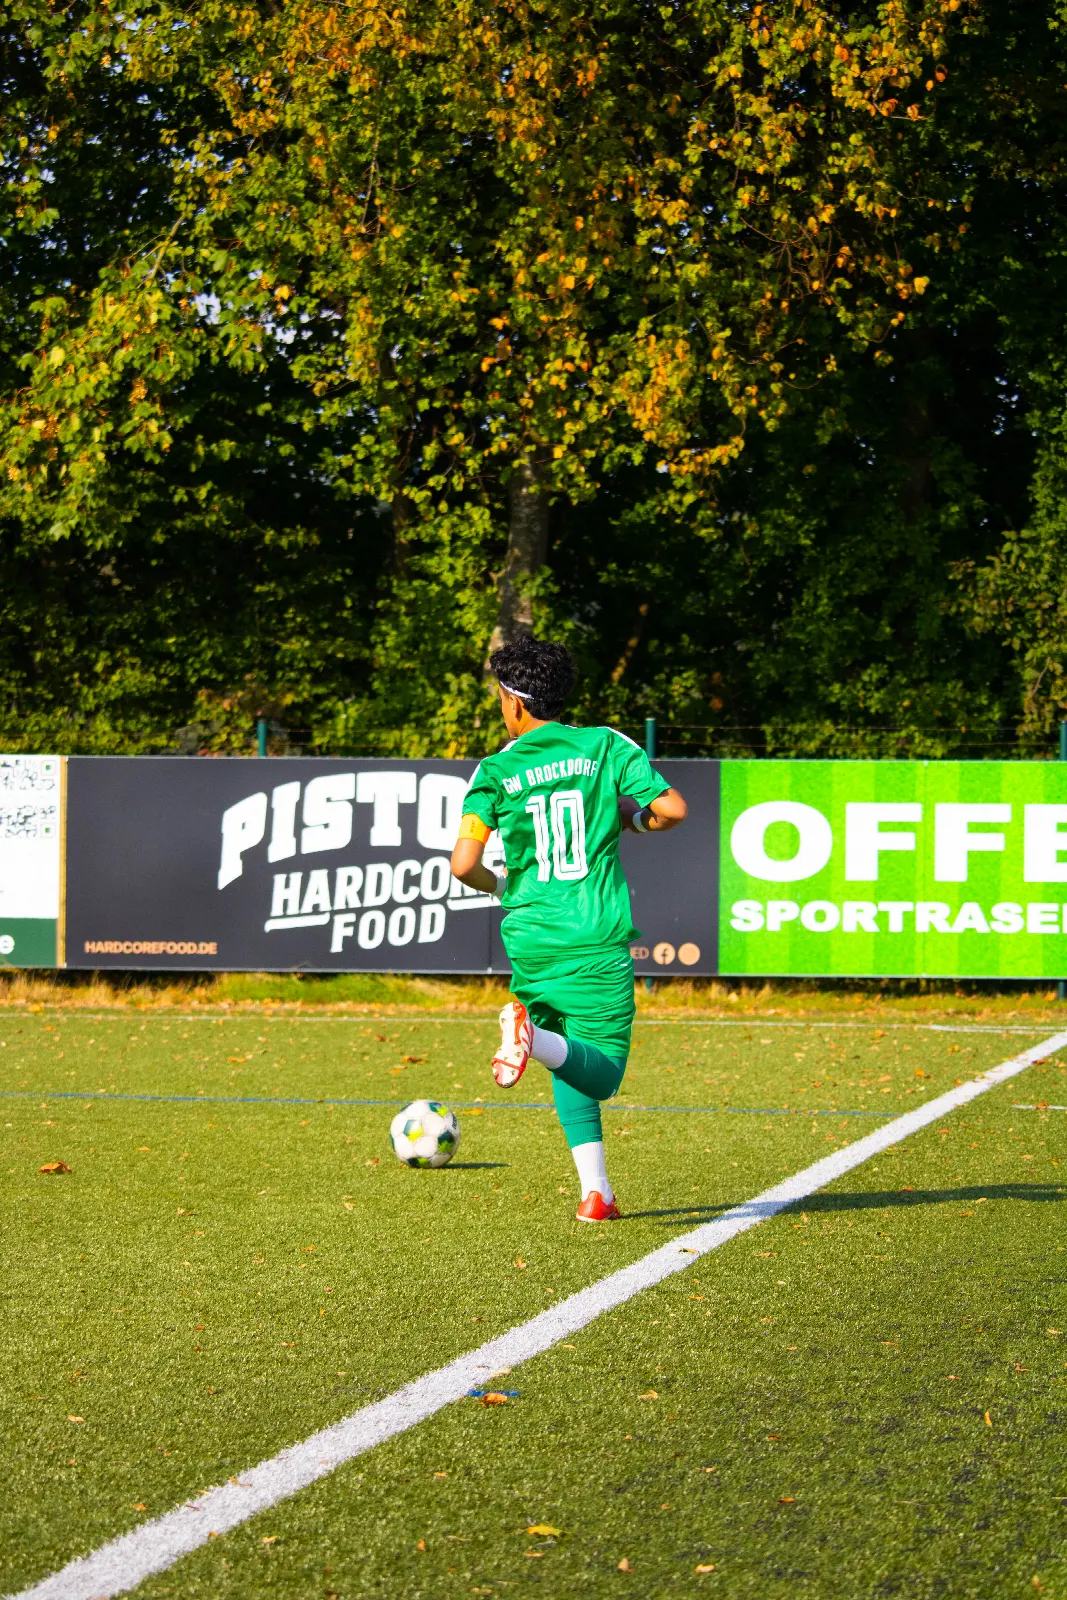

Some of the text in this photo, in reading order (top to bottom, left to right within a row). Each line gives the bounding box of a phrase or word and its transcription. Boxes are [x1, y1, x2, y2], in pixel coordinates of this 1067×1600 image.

[502, 757, 598, 795] GW BROCKDORF
[217, 771, 504, 891] PISTO
[524, 789, 589, 882] 10
[330, 903, 446, 953] FOOD
[730, 900, 1067, 933] SPORTRASE
[84, 940, 218, 955] HARDCOREFOOD.DE
